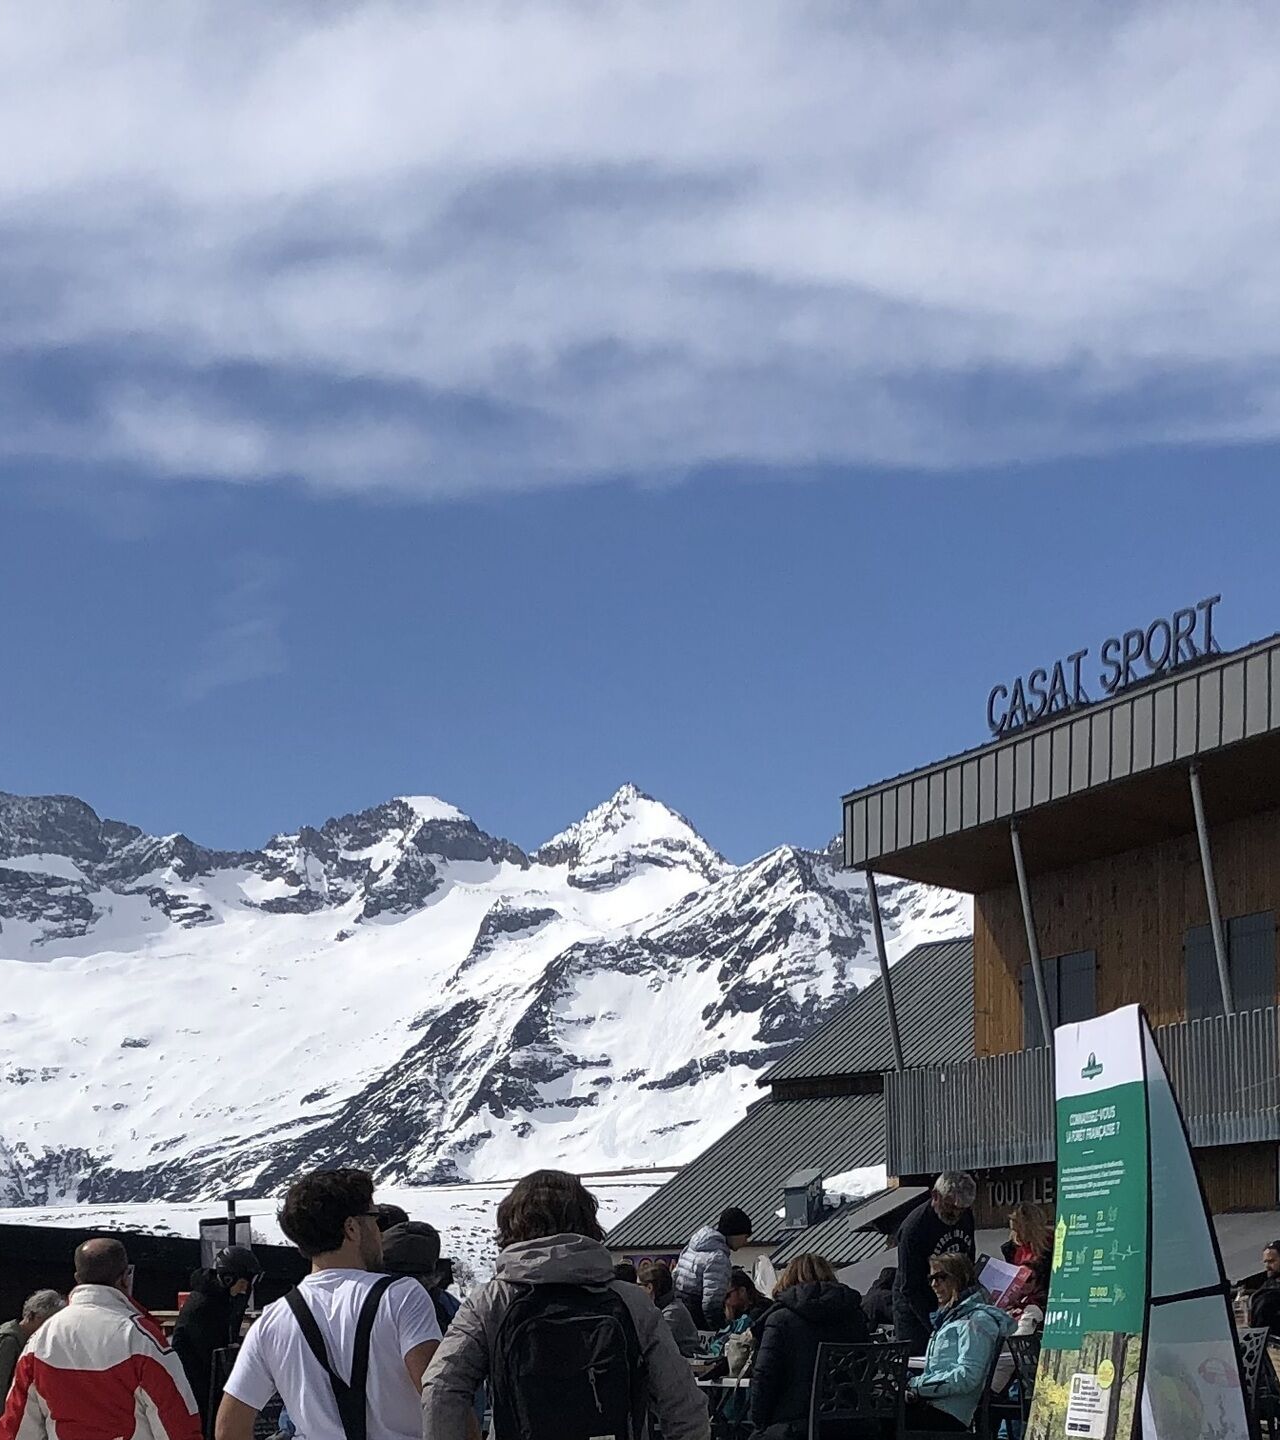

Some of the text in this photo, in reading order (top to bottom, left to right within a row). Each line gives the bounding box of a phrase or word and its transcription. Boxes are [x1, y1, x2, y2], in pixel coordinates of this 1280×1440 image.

[987, 594, 1222, 736] CASAT SPORT
[986, 1180, 1023, 1207] TOUT
